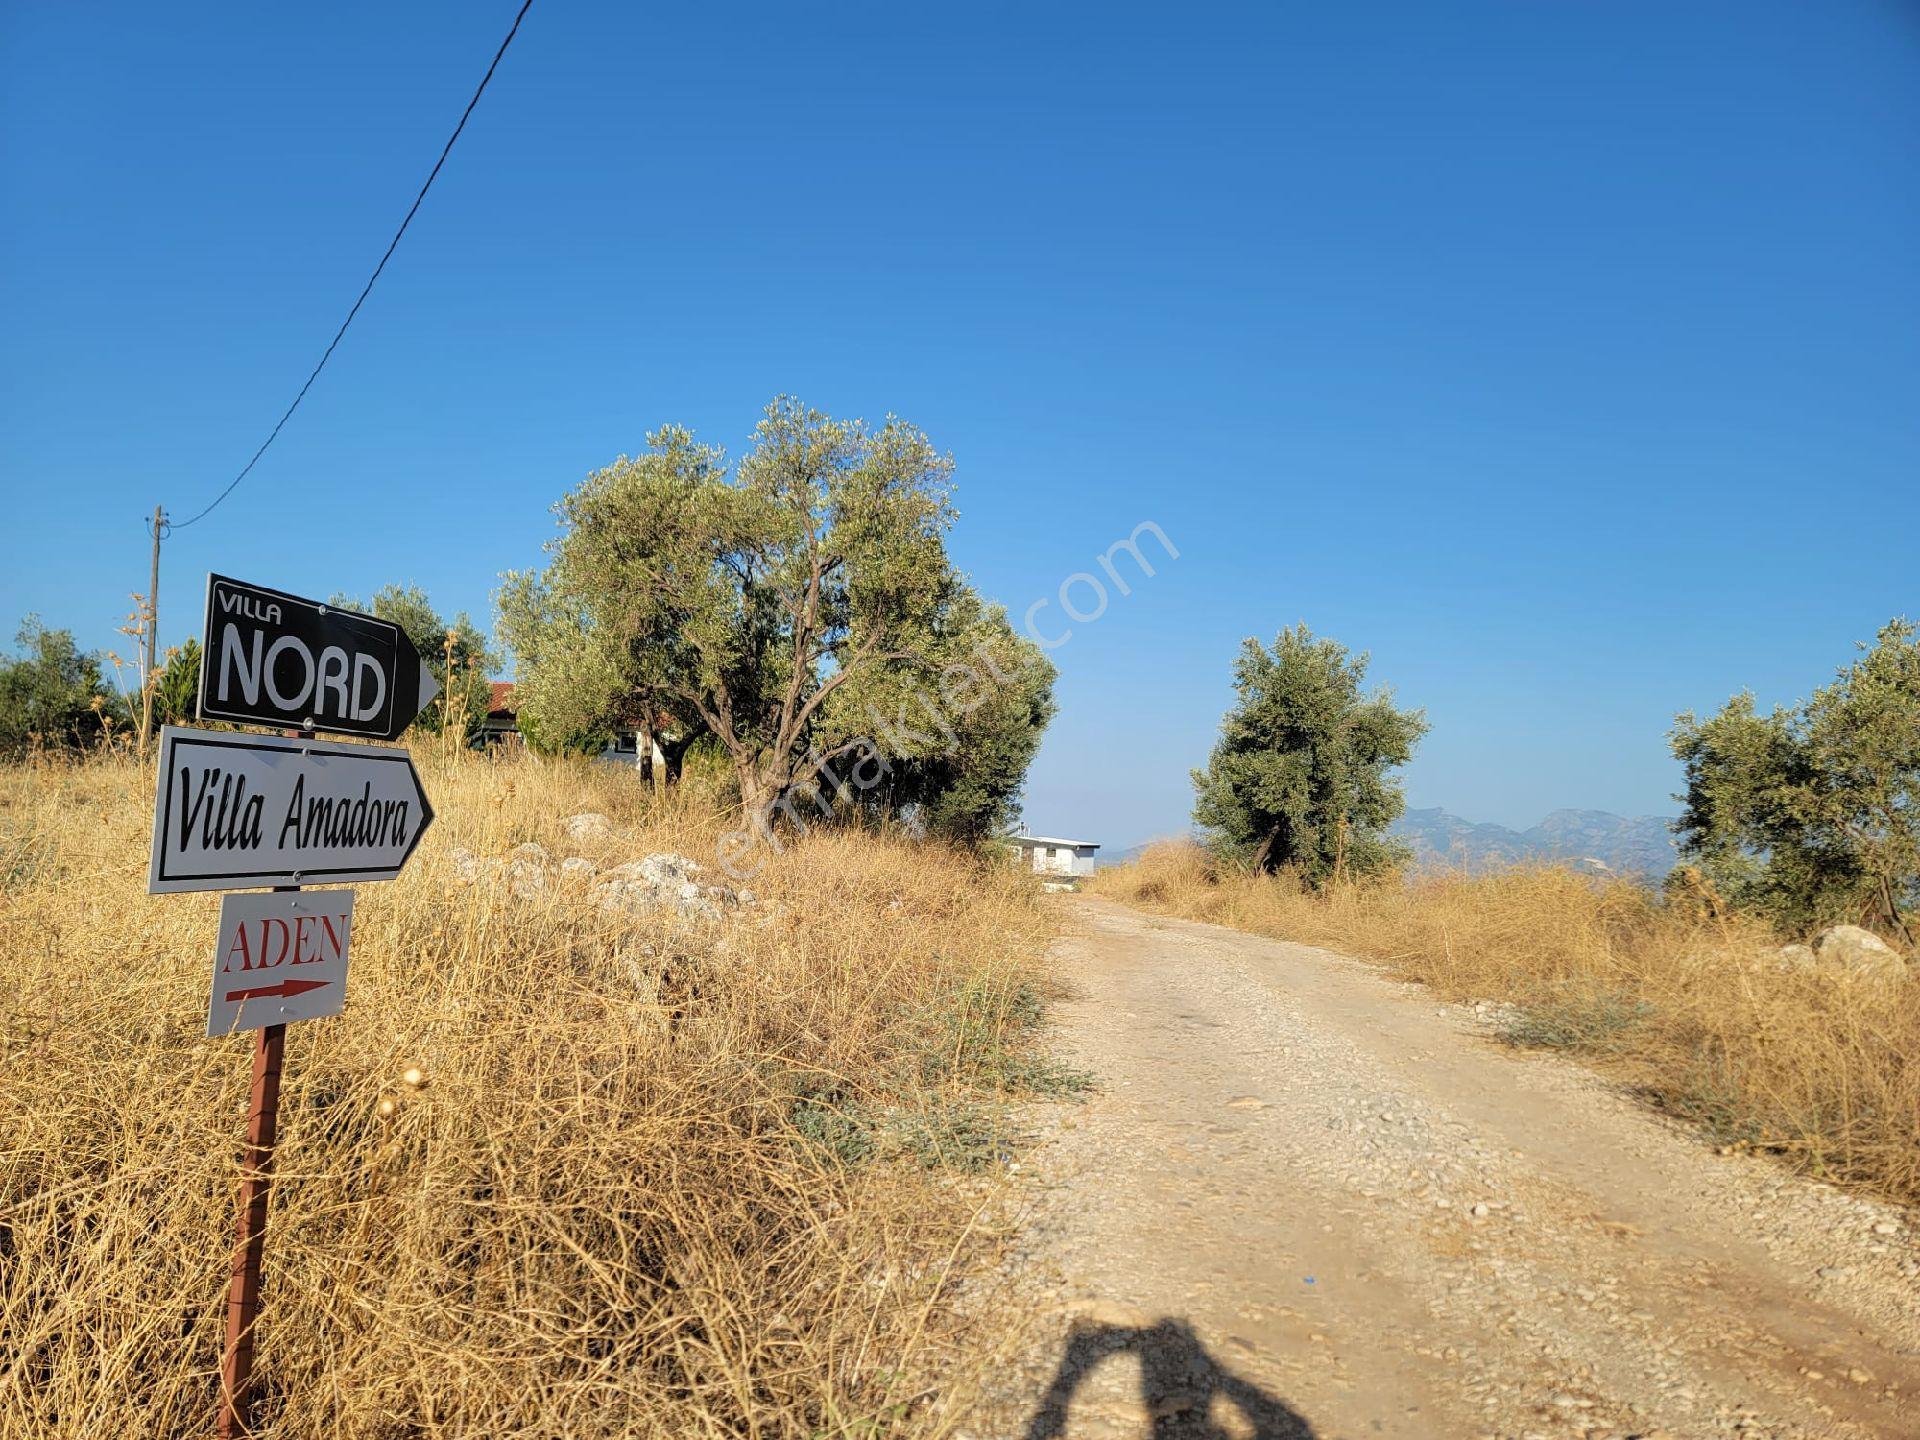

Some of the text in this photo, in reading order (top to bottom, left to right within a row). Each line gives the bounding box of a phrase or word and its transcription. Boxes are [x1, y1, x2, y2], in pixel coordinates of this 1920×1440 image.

[218, 590, 282, 625] VILLA
[217, 623, 387, 722] NORD
[180, 766, 409, 853] Villa Amadora
[223, 914, 349, 973] ADEN
